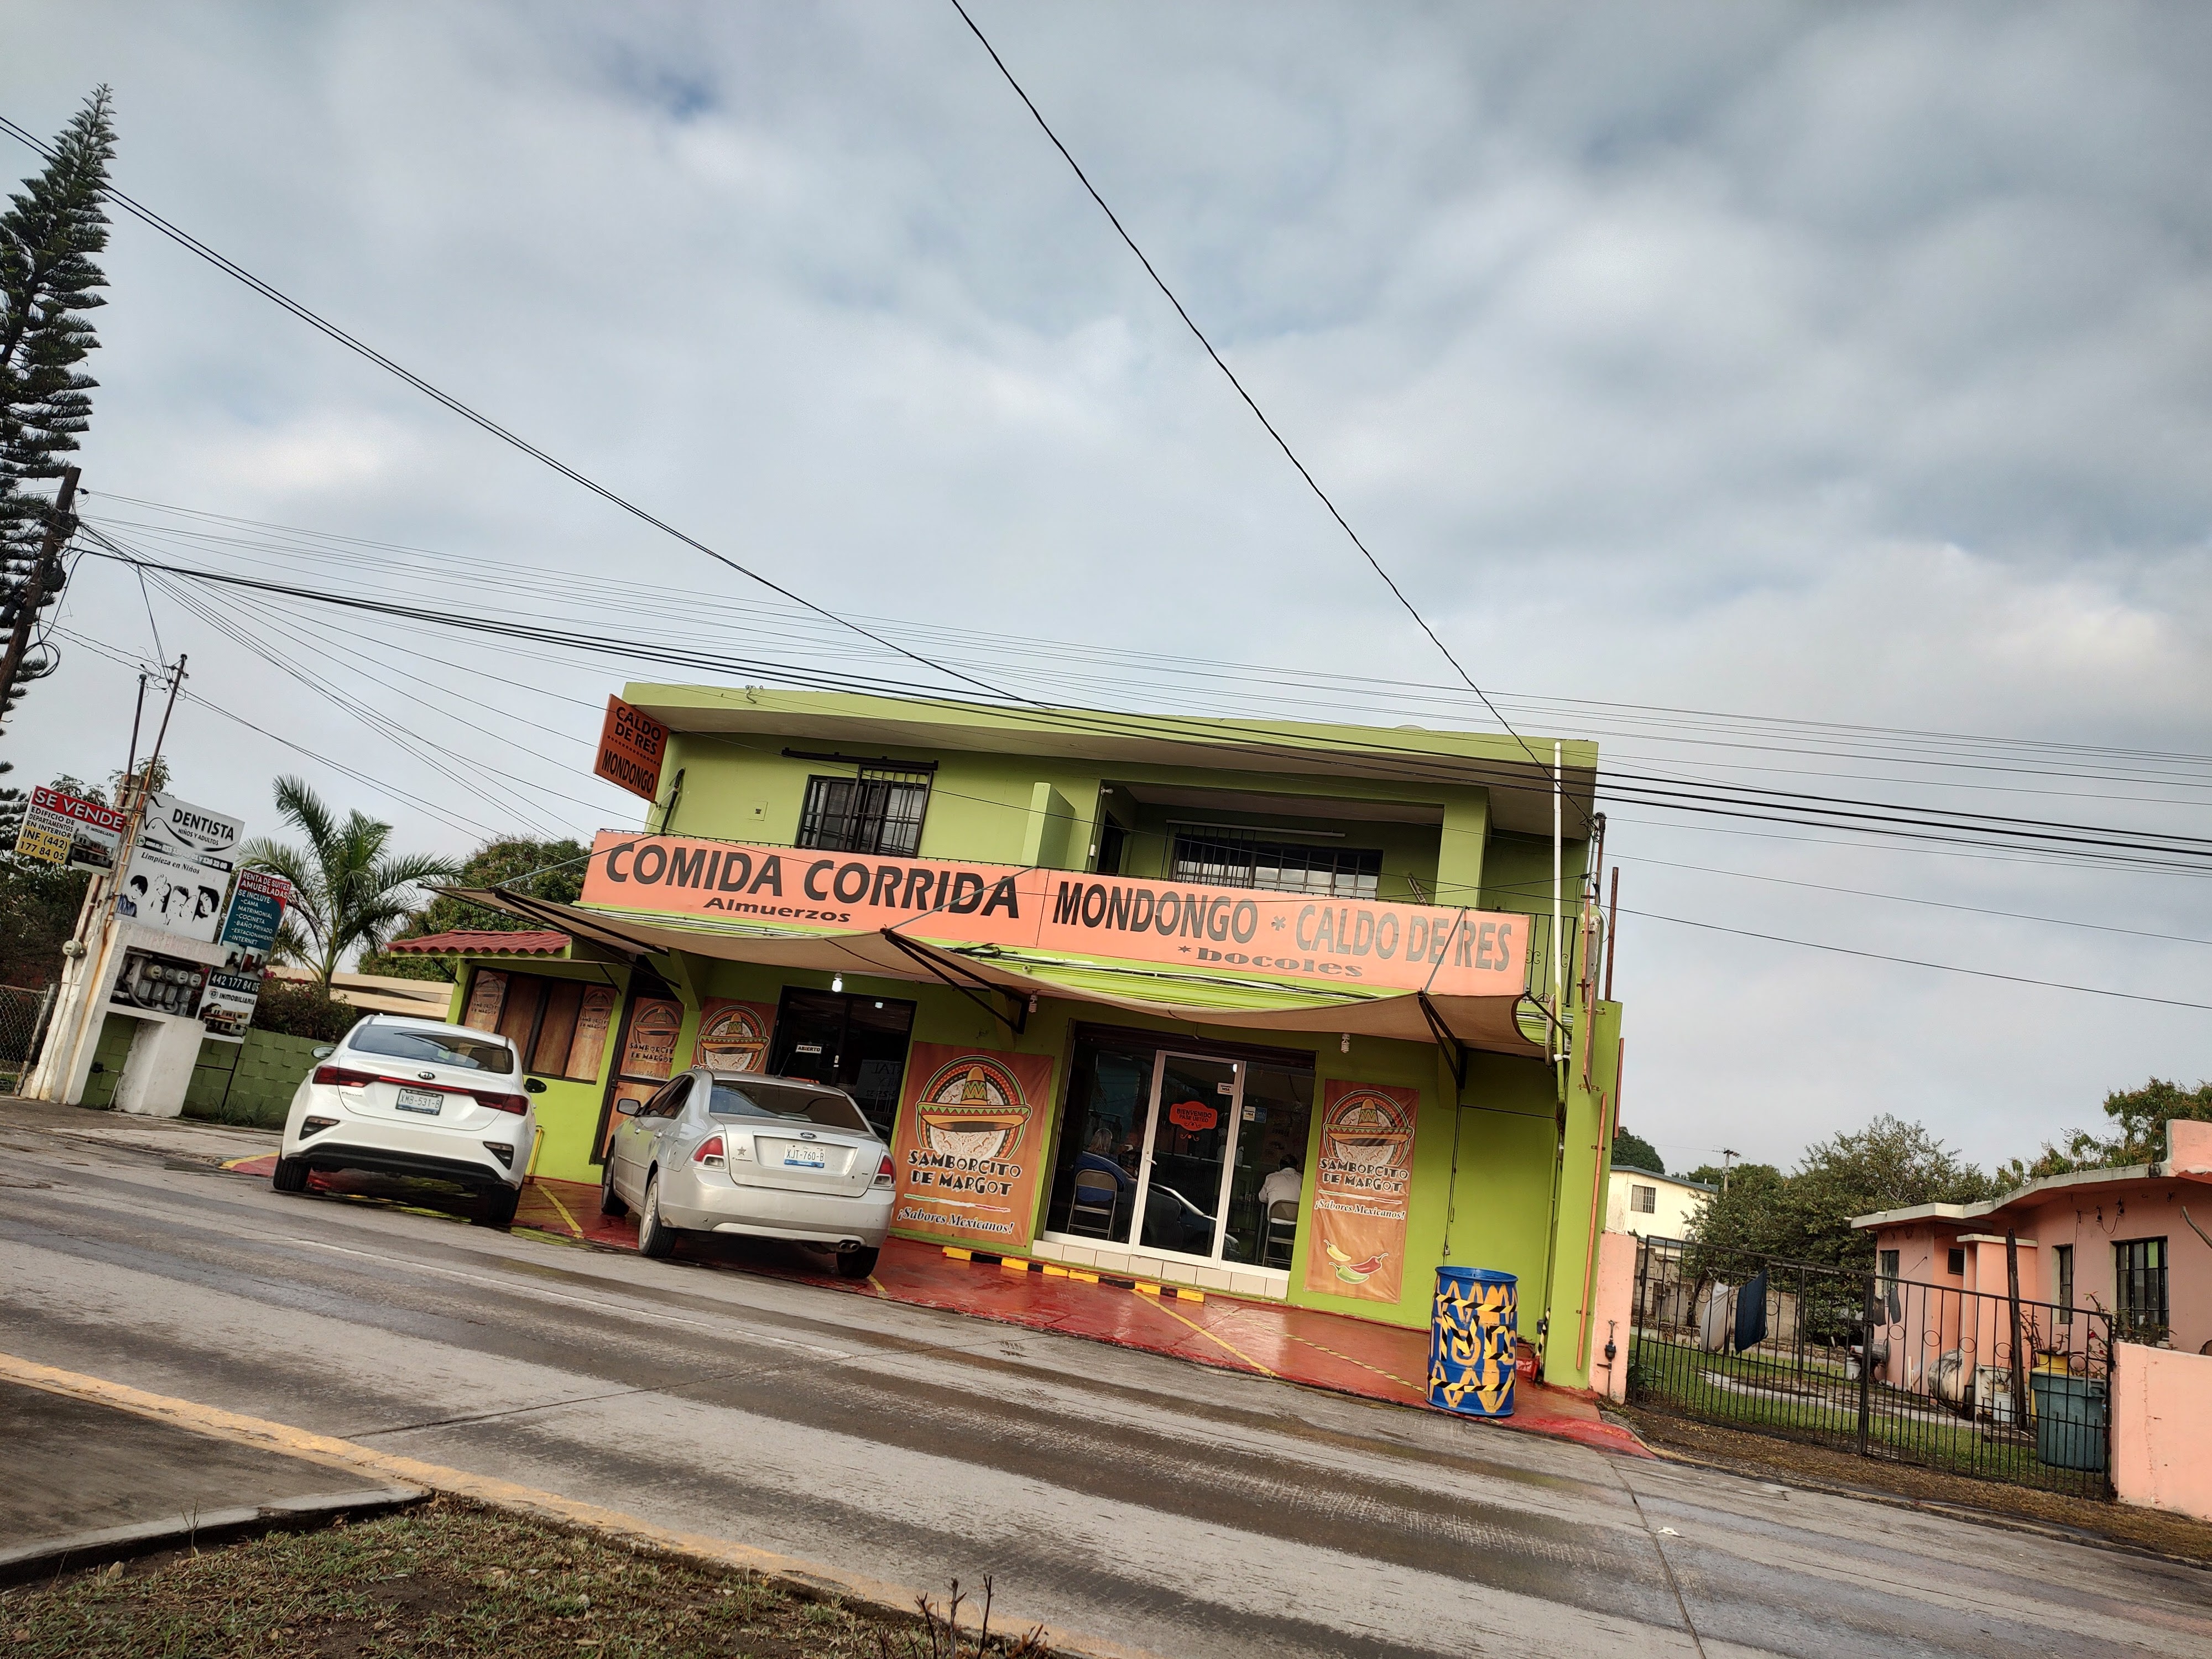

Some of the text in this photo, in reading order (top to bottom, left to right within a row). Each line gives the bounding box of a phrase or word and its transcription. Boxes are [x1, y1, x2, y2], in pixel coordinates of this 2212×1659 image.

[616, 707, 661, 741] CALDO
[615, 722, 658, 755] DE RES
[602, 749, 654, 794] MONDONGO
[30, 806, 64, 822] EDIFICIO
[35, 790, 124, 830] SE VENDE
[27, 820, 72, 839] EN INTERIOR
[29, 813, 74, 832] DEPARTAMENTOS
[172, 808, 234, 841] DENTISTA
[23, 828, 67, 852] INF. (442)
[178, 827, 193, 837] NIÑOS
[197, 834, 219, 846] ADULTOS
[20, 841, 65, 860] 177 84 05
[141, 852, 171, 867] Limpieza
[181, 863, 200, 874] Niños
[241, 880, 288, 899] AMUEBLADAS
[243, 871, 290, 891] RENTA DE SUITES
[606, 842, 1020, 919] COMIDA CORRIDA
[238, 905, 273, 919] MATRIMONIAL
[703, 897, 851, 922] Almuerzos
[1052, 880, 1258, 944] MONDONGO
[253, 924, 273, 934] PRIVADO
[1296, 904, 1513, 972] CALDO DE RES
[212, 974, 260, 992] 442 177 84 05
[219, 993, 255, 1005] INMOBILIARIA
[629, 1042, 674, 1055] SAMBORCIT
[642, 1053, 674, 1063] MARGOT
[1176, 1108, 1212, 1119] BIENVENIDO
[786, 1149, 824, 1161] XJT-760-B
[909, 1150, 1022, 1178] SAMBORCITO
[1319, 1158, 1409, 1179] SAMBORCITO
[912, 1169, 1013, 1196] DE MARGOT
[1323, 1172, 1402, 1192] DE MARGOT
[1315, 1199, 1406, 1220] ¡Sabores Mexicanos!
[898, 1206, 1014, 1234] ¡Sabores Mexicanos!
